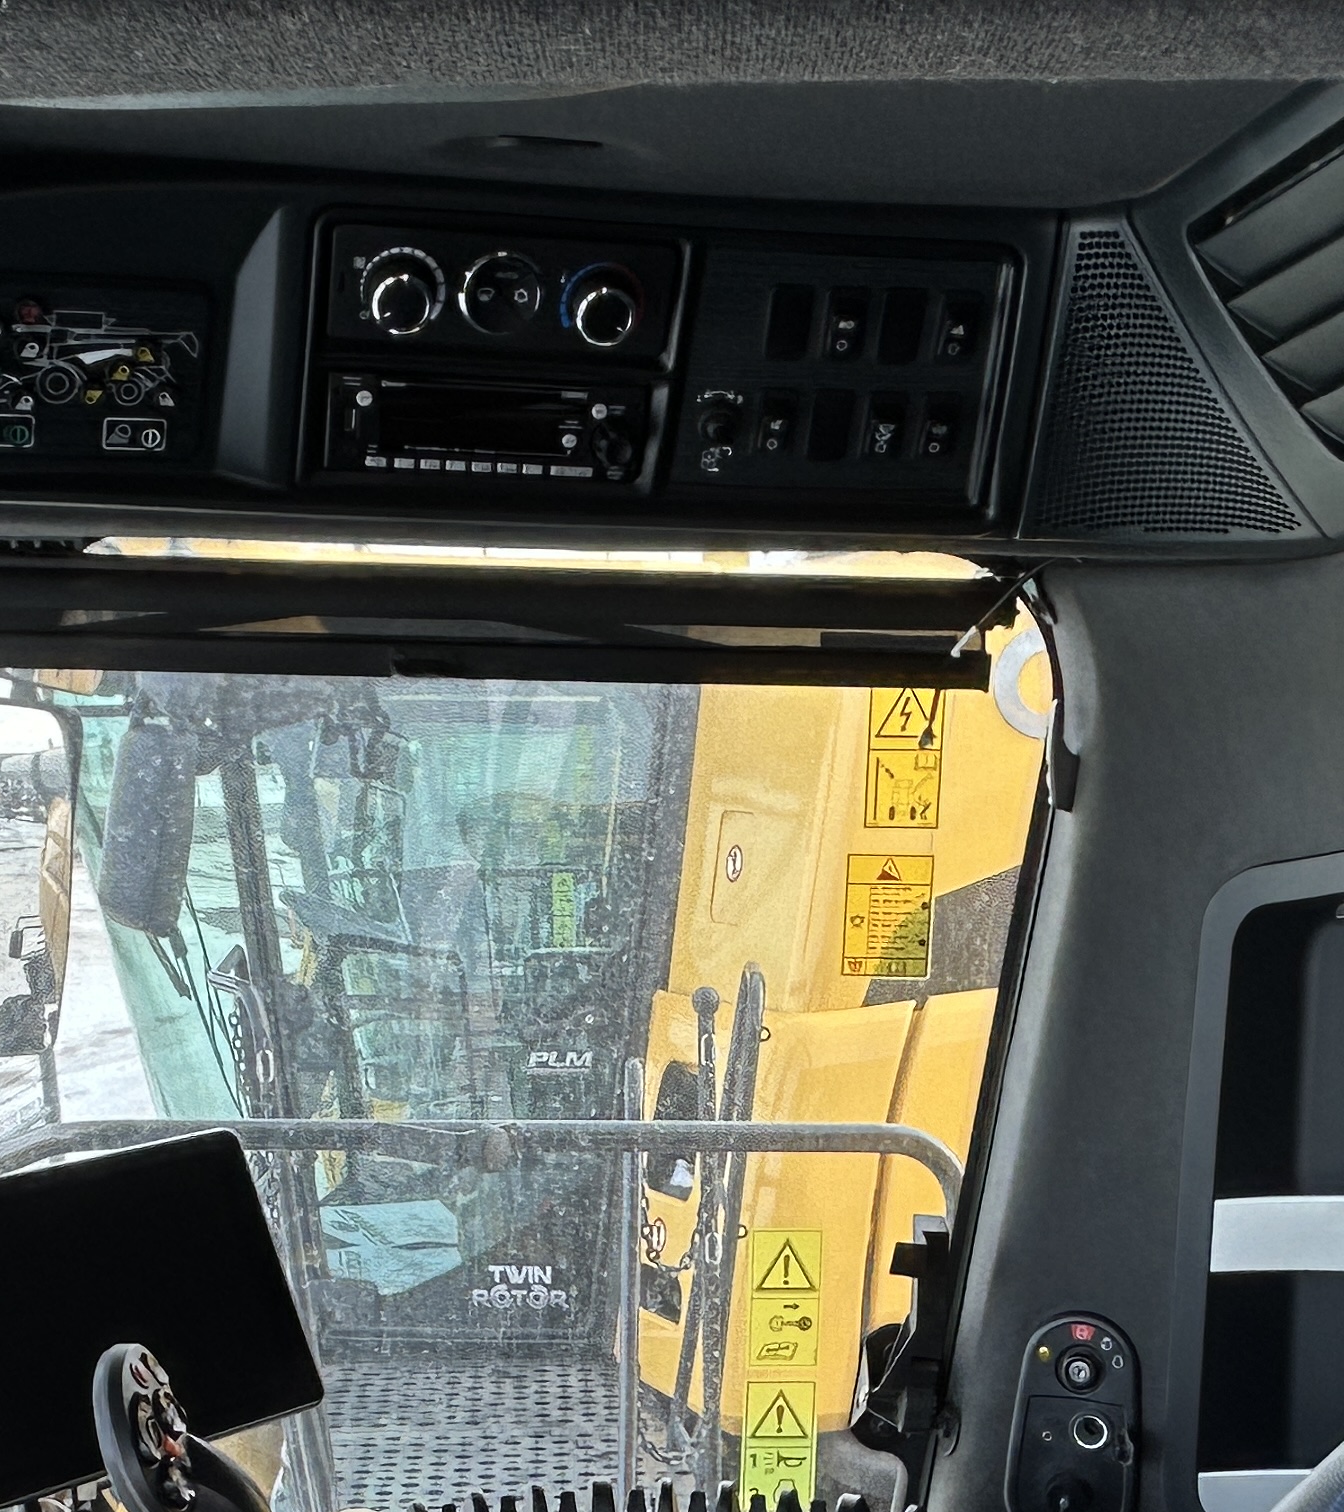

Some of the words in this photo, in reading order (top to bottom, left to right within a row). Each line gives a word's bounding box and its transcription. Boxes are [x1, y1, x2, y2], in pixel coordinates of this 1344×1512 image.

[527, 1050, 593, 1067] PLM
[487, 1264, 553, 1285] TWIN
[471, 1283, 570, 1310] ROTOR
